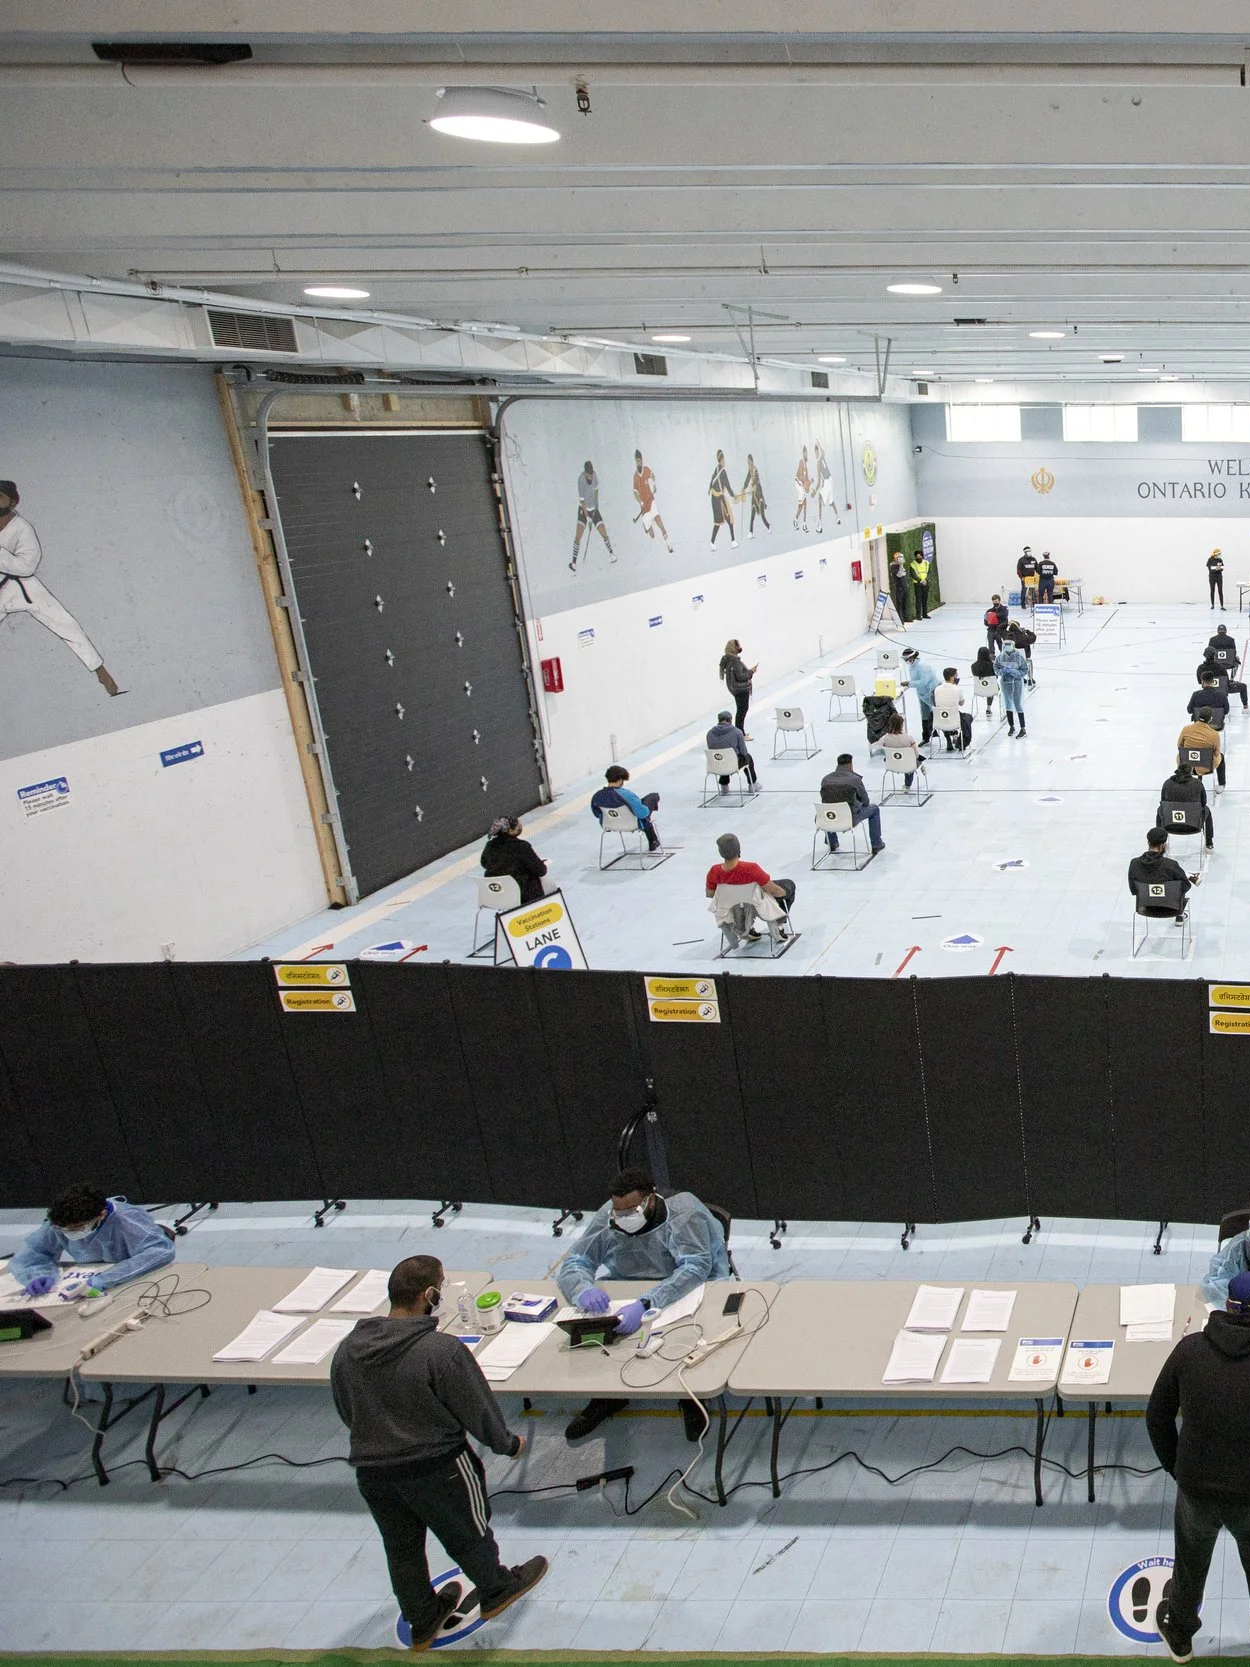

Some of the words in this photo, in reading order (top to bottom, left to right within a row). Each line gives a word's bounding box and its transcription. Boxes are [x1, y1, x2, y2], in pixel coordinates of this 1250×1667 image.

[1137, 481, 1227, 499] ONTARIO
[20, 784, 57, 798] Reminder
[516, 908, 552, 926] Vaccination
[524, 918, 550, 932] Stations
[525, 928, 560, 951] LANE
[1138, 1559, 1160, 1569] Wait
[1162, 1558, 1174, 1567] he
